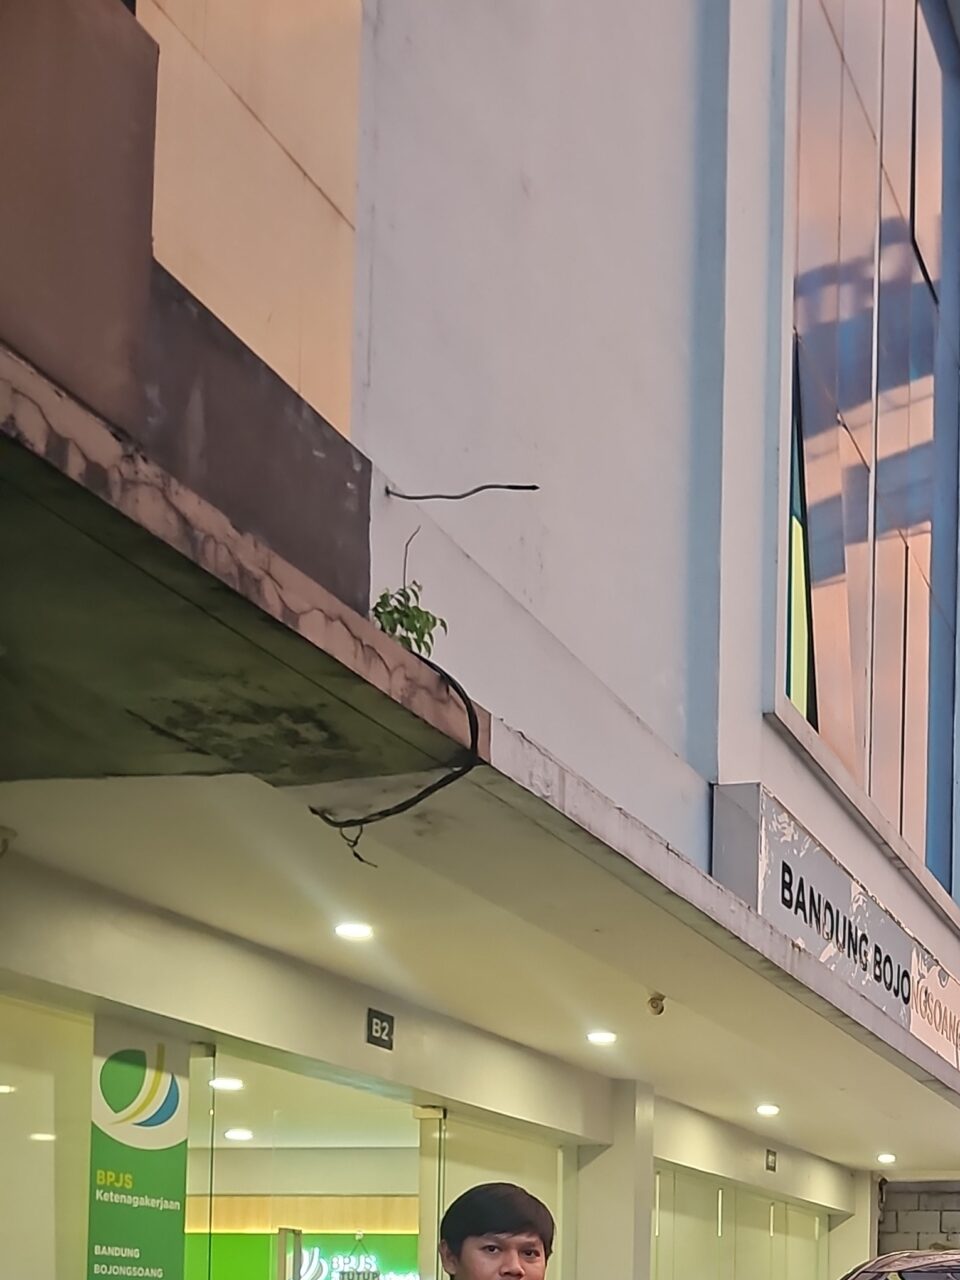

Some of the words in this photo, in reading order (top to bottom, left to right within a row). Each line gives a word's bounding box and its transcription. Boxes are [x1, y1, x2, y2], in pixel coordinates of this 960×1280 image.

[781, 860, 869, 972] BANDUNG
[372, 1018, 389, 1041] B2
[96, 1169, 134, 1189] BPJS
[95, 1188, 181, 1211] Ketenagakerjaan
[94, 1245, 141, 1258] BANDUNG
[93, 1263, 164, 1278] BOJONGSOANG
